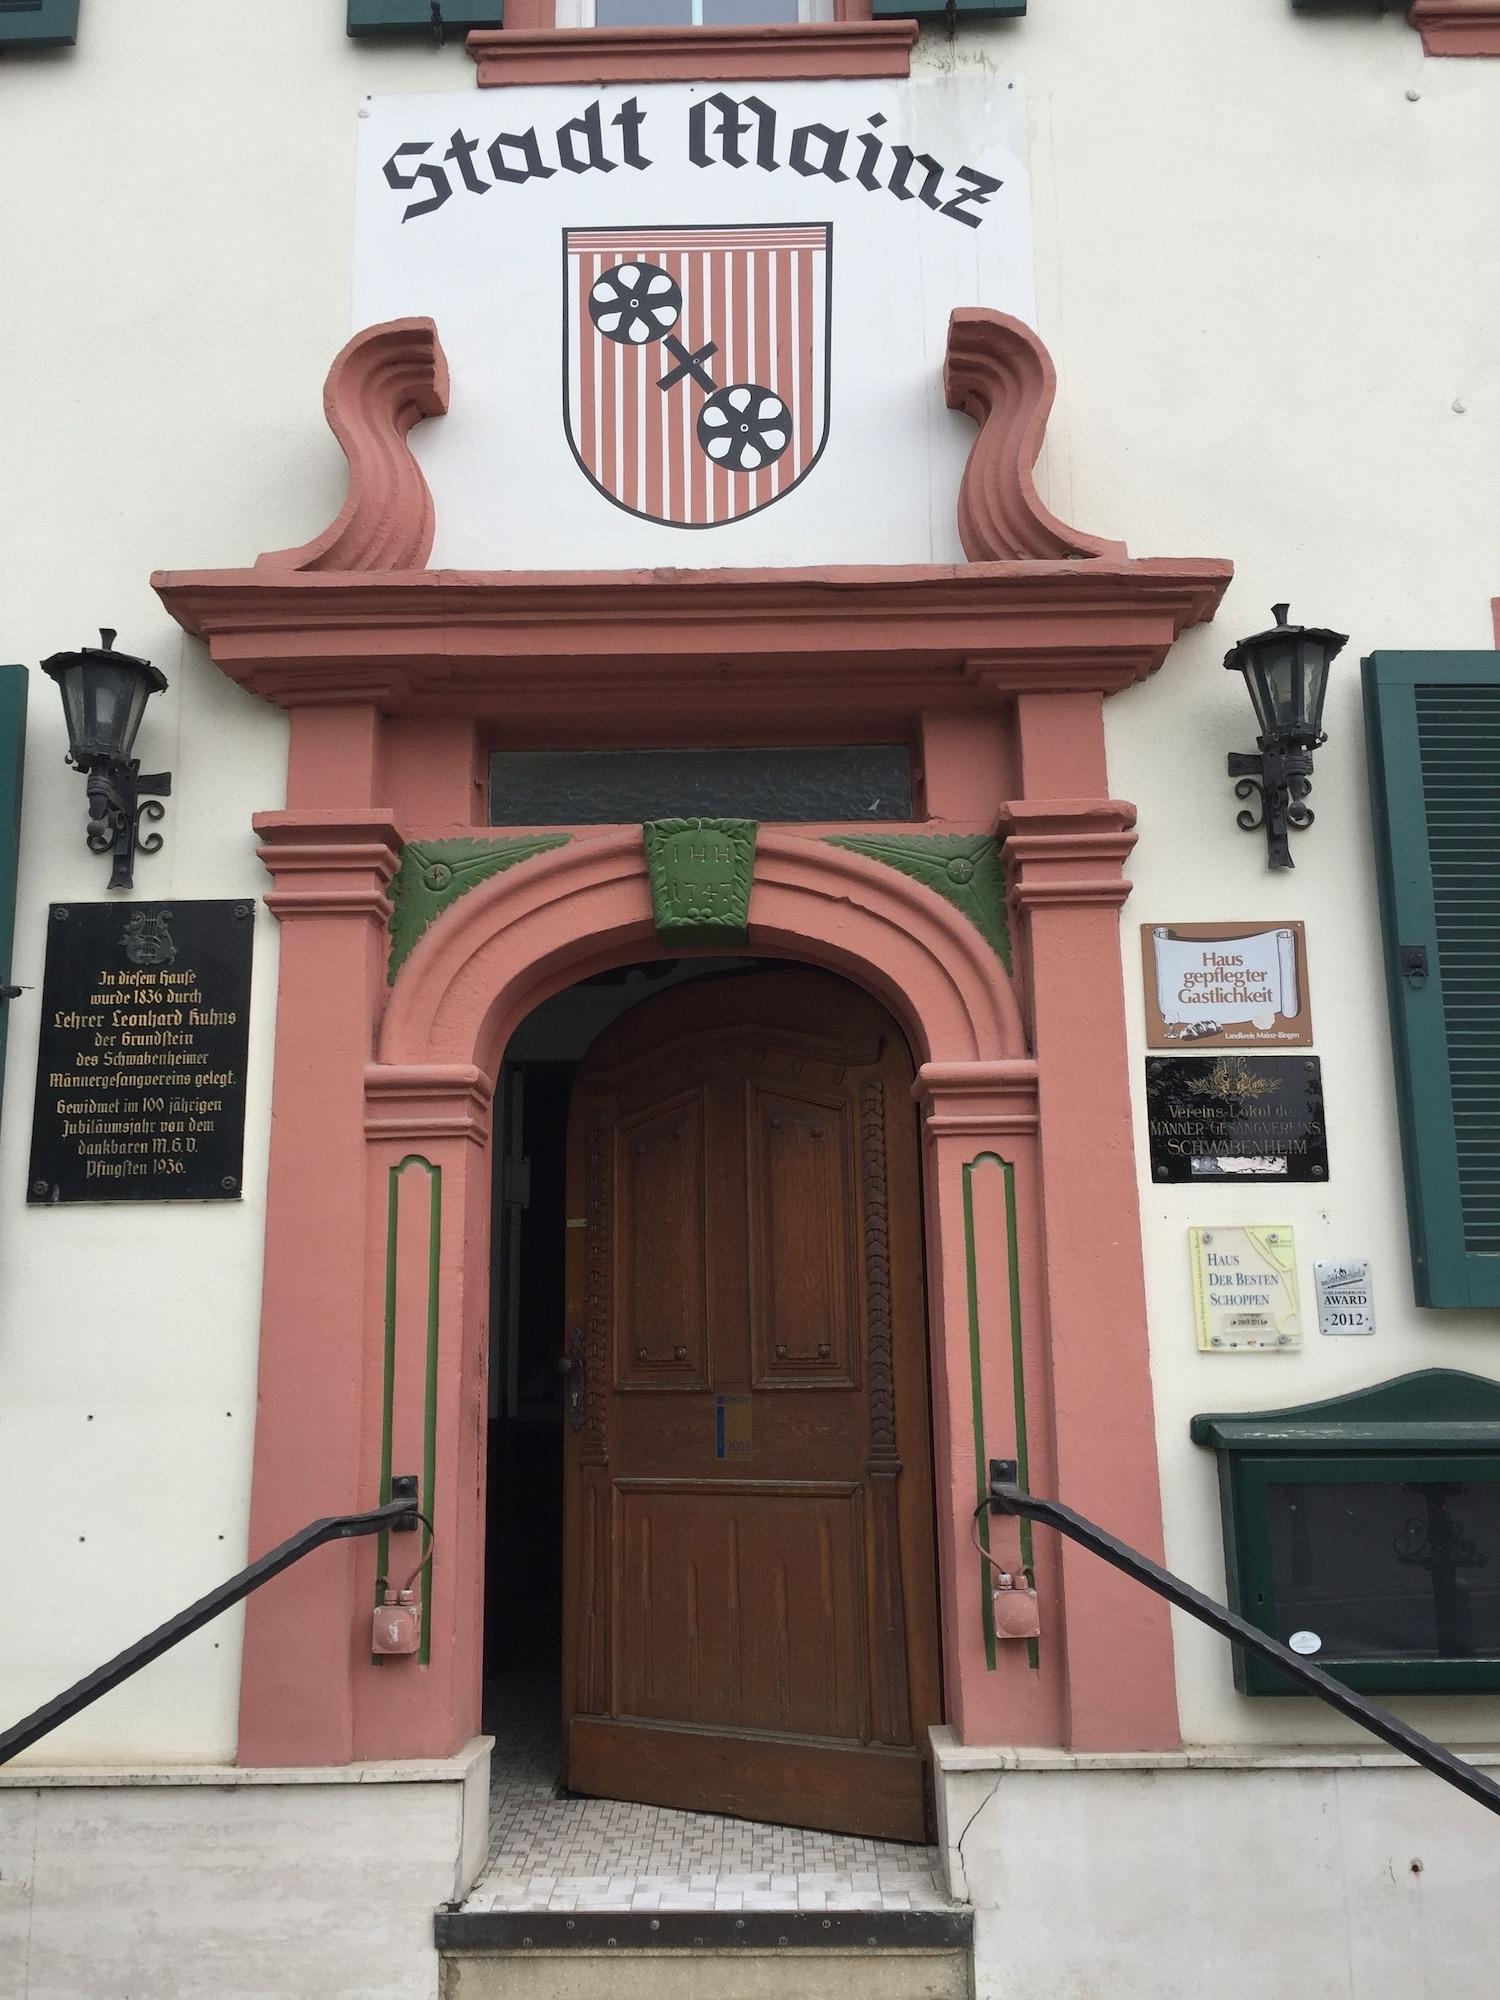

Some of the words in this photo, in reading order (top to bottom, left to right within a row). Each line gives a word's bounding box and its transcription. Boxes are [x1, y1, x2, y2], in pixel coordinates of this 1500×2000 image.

[381, 96, 654, 225] Stadt
[688, 91, 1005, 230] Mainz
[1202, 952, 1244, 967] Haus
[98, 971, 115, 985] In
[1183, 967, 1268, 988] gepflegter
[90, 991, 131, 1005] wurde
[134, 989, 163, 1005] 1836
[166, 988, 202, 1004] durch
[1178, 987, 1273, 1004] Gastlichkeit
[54, 1011, 105, 1030] Lehrer
[112, 1009, 183, 1028] Leonhard
[94, 1032, 117, 1047] der
[76, 1052, 99, 1067] des
[103, 1050, 209, 1067] Schwabenheimer
[56, 1098, 120, 1115] Gewidmet
[123, 1098, 139, 1113] im
[143, 1097, 165, 1112] 100
[168, 1096, 222, 1115] jährigen
[160, 1119, 184, 1133] von
[188, 1117, 215, 1133] dem
[78, 1139, 149, 1156] dankbaren
[1167, 1138, 1307, 1156] SCHWABENHEIM
[1207, 1253, 1240, 1267] HAUS
[1209, 1272, 1234, 1286] DER
[1236, 1272, 1280, 1286] BESTEN
[1210, 1293, 1270, 1307] SCHOPPEN
[1324, 1295, 1367, 1305] AWARD
[1331, 1313, 1363, 1326] 2012
